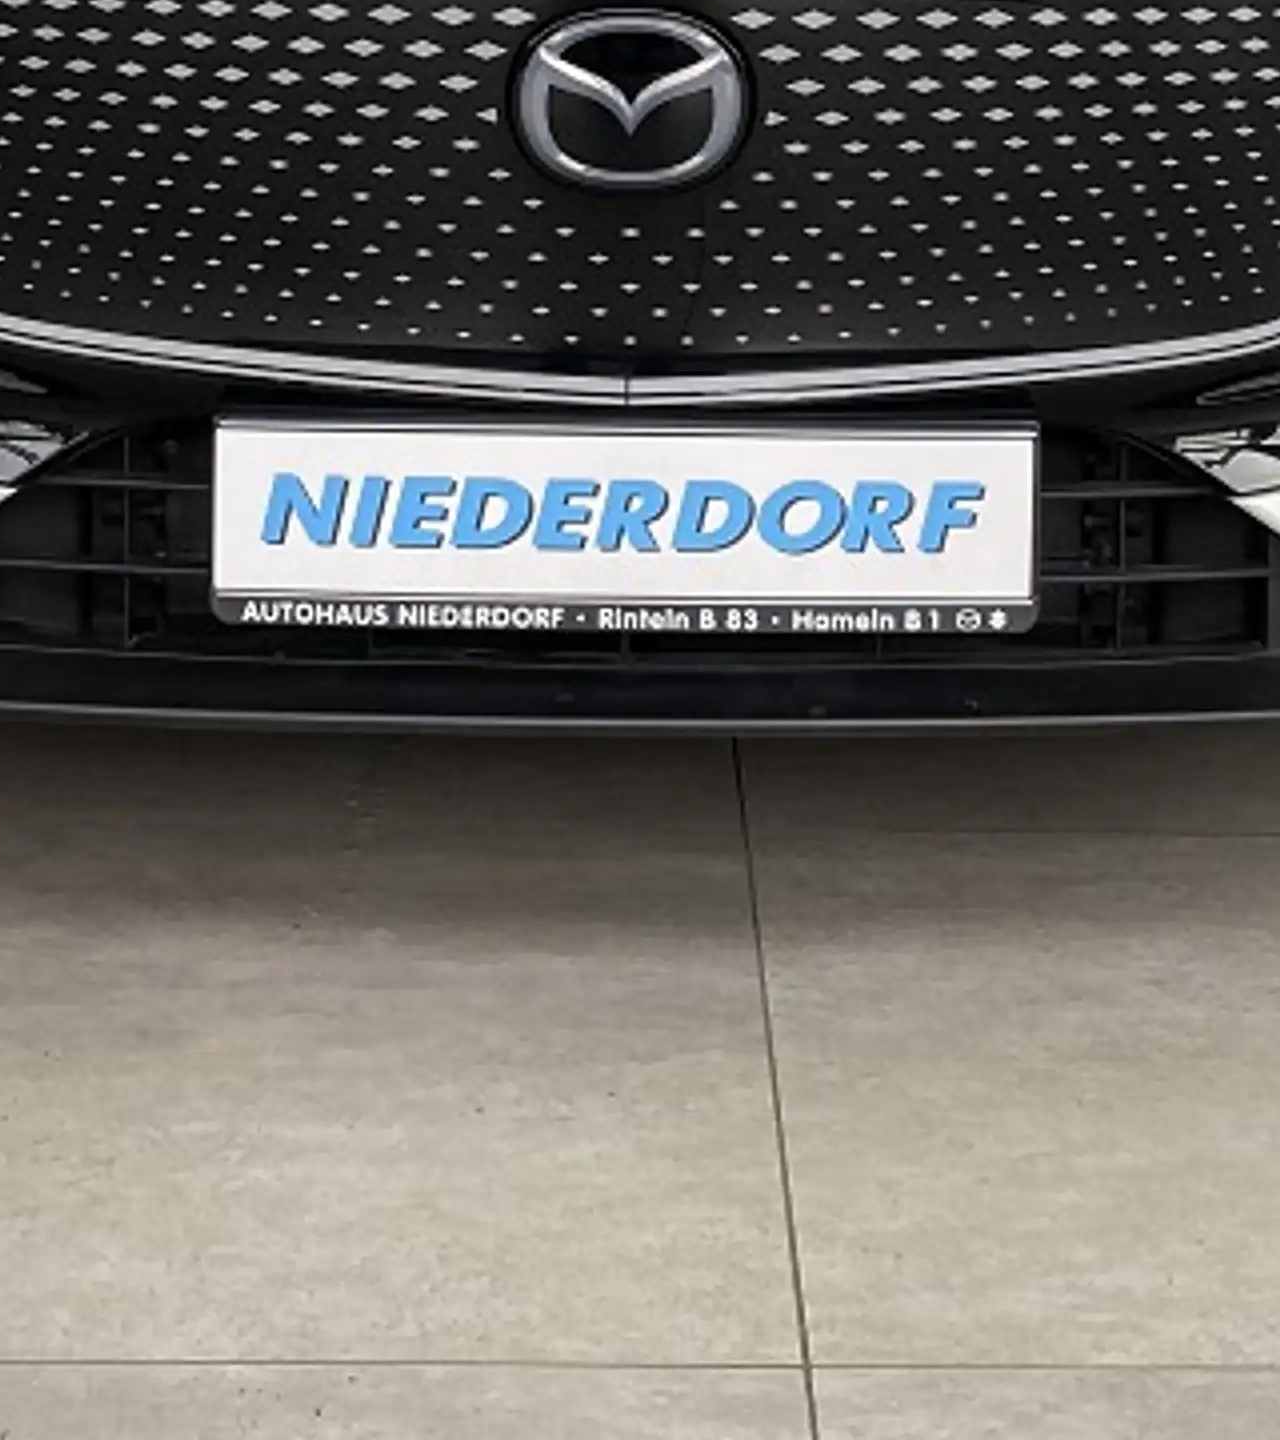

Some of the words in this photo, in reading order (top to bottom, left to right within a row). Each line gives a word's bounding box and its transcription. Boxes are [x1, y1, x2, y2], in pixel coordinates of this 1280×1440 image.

[261, 472, 985, 554] NIEDERDORF
[241, 599, 389, 625] AUTOHAUS
[397, 603, 564, 629] NIEDERDORF
[700, 609, 715, 630] B
[724, 609, 758, 630] 83
[928, 610, 939, 630] 1
